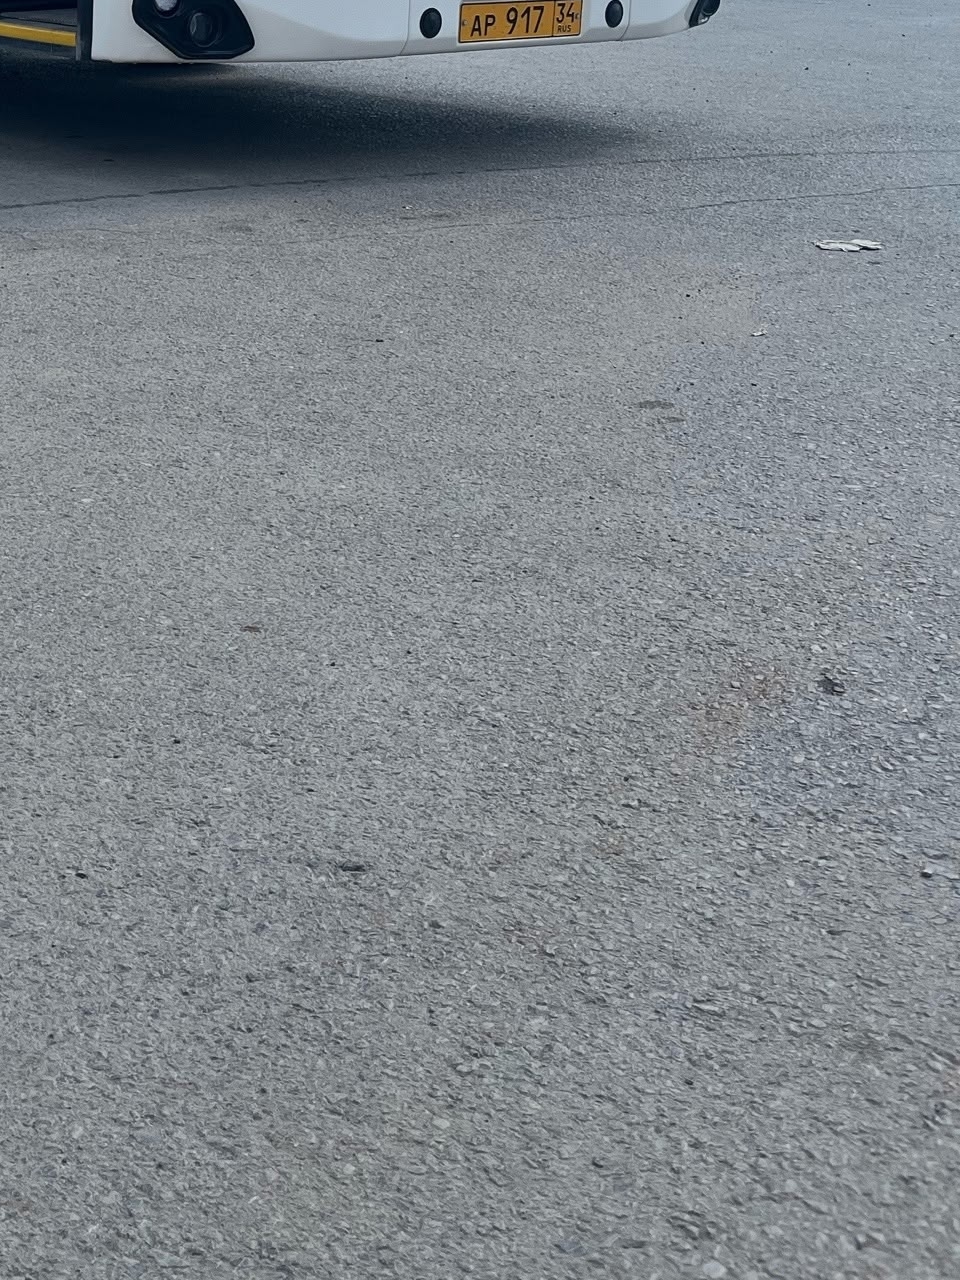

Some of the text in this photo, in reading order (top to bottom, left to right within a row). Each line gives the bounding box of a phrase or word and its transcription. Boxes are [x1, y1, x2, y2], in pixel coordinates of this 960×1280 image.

[469, 2, 575, 37] АР 917 34
[557, 24, 572, 33] RUS
